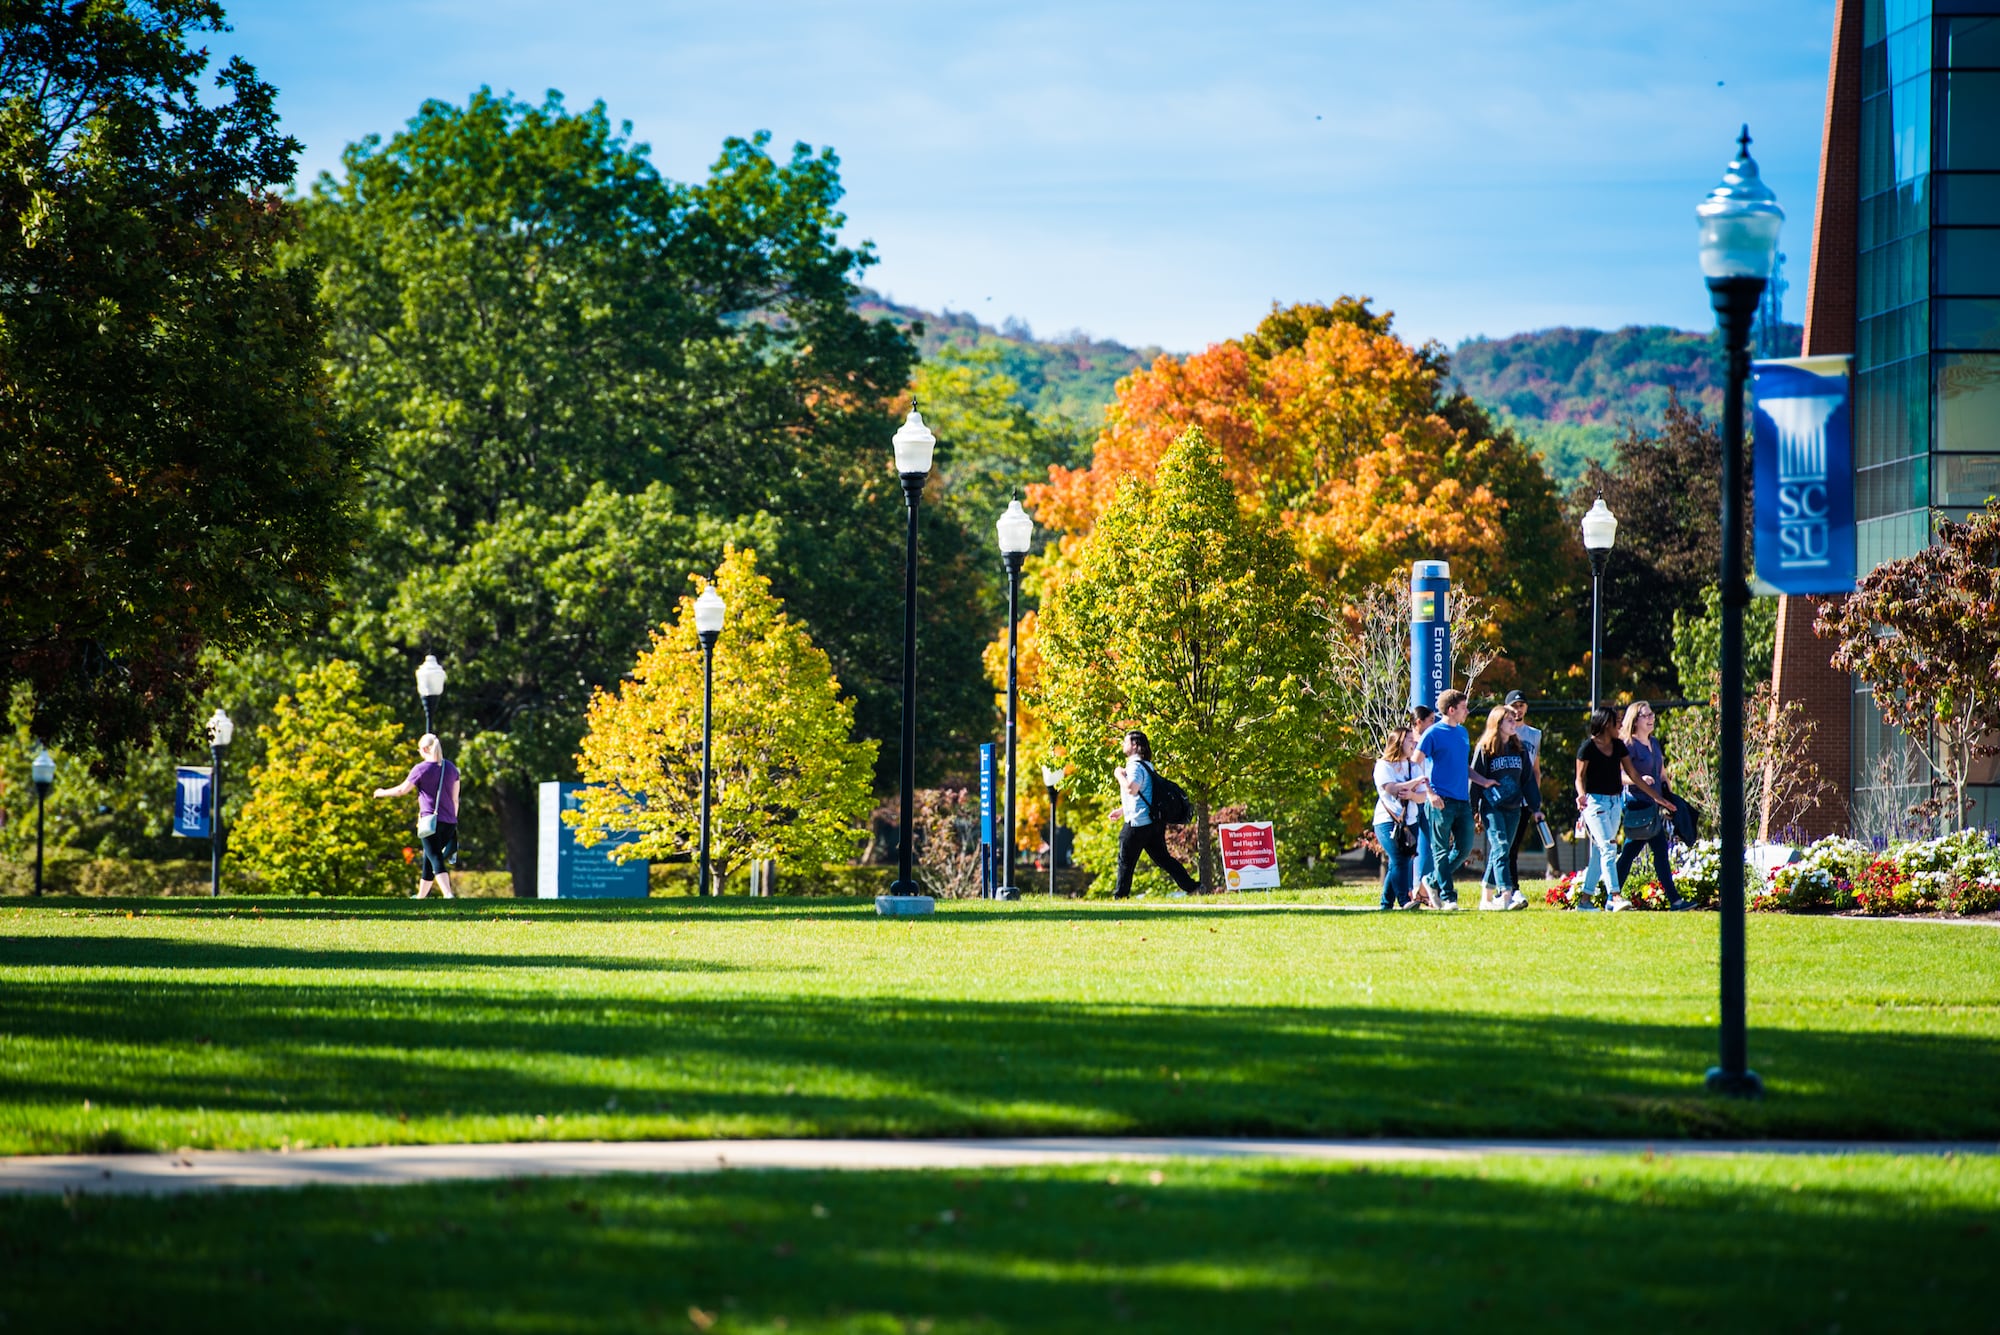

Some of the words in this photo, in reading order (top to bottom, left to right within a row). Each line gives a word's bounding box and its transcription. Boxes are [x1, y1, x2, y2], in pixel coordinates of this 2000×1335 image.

[1779, 485, 1827, 518] SC
[1780, 526, 1828, 559] SU
[183, 805, 201, 816] SC
